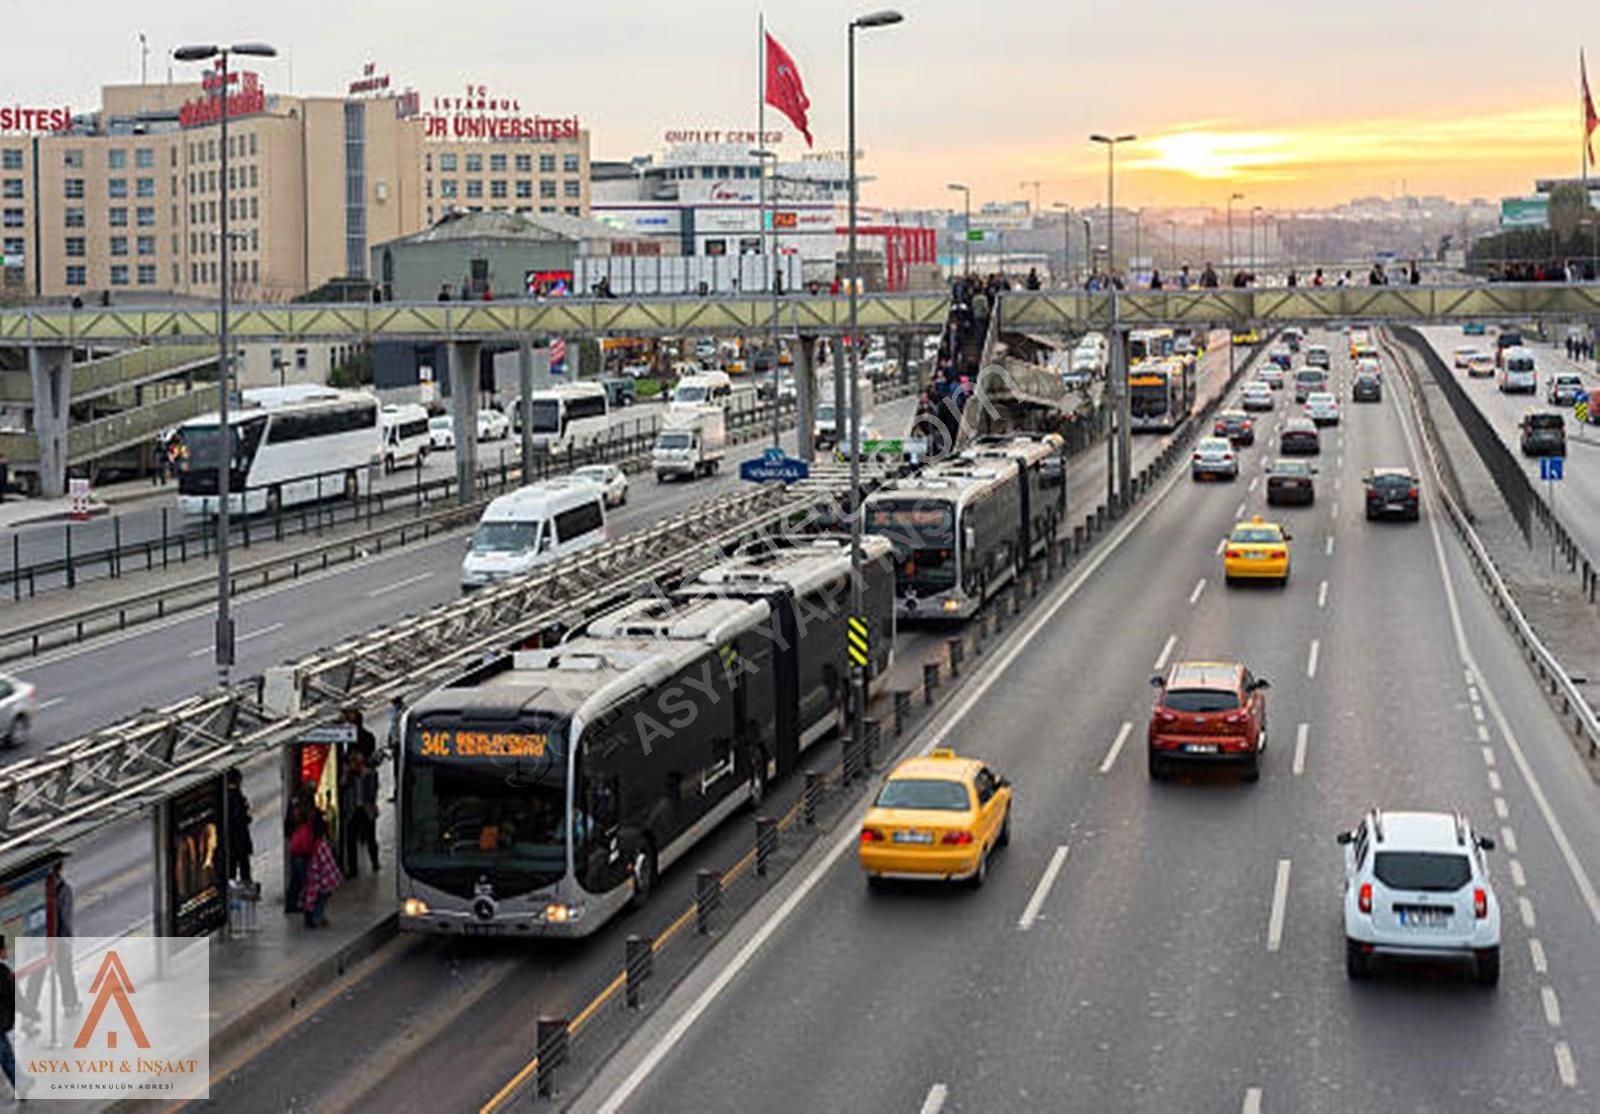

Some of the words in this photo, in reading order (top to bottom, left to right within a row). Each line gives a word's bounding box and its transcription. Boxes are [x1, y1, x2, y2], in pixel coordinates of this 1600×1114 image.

[664, 130, 720, 143] OUTLET
[726, 130, 783, 144] CENER
[420, 731, 450, 756] 34C
